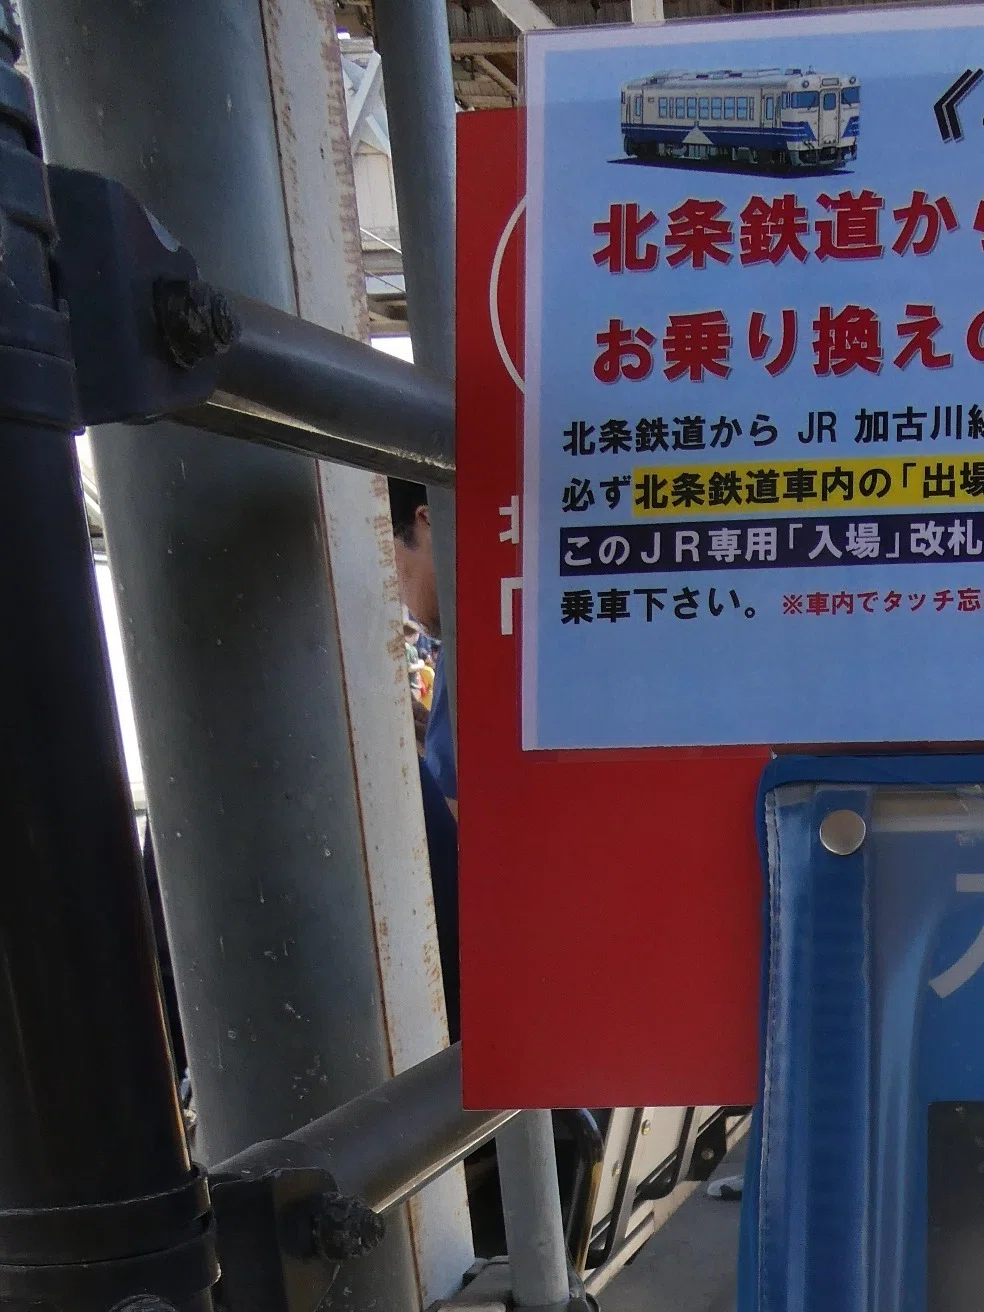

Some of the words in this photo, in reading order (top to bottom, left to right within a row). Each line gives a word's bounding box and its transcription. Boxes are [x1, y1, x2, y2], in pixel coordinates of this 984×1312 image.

[562, 413, 778, 456] 北条鉄道から
[561, 586, 756, 625] 乗車下さい。
